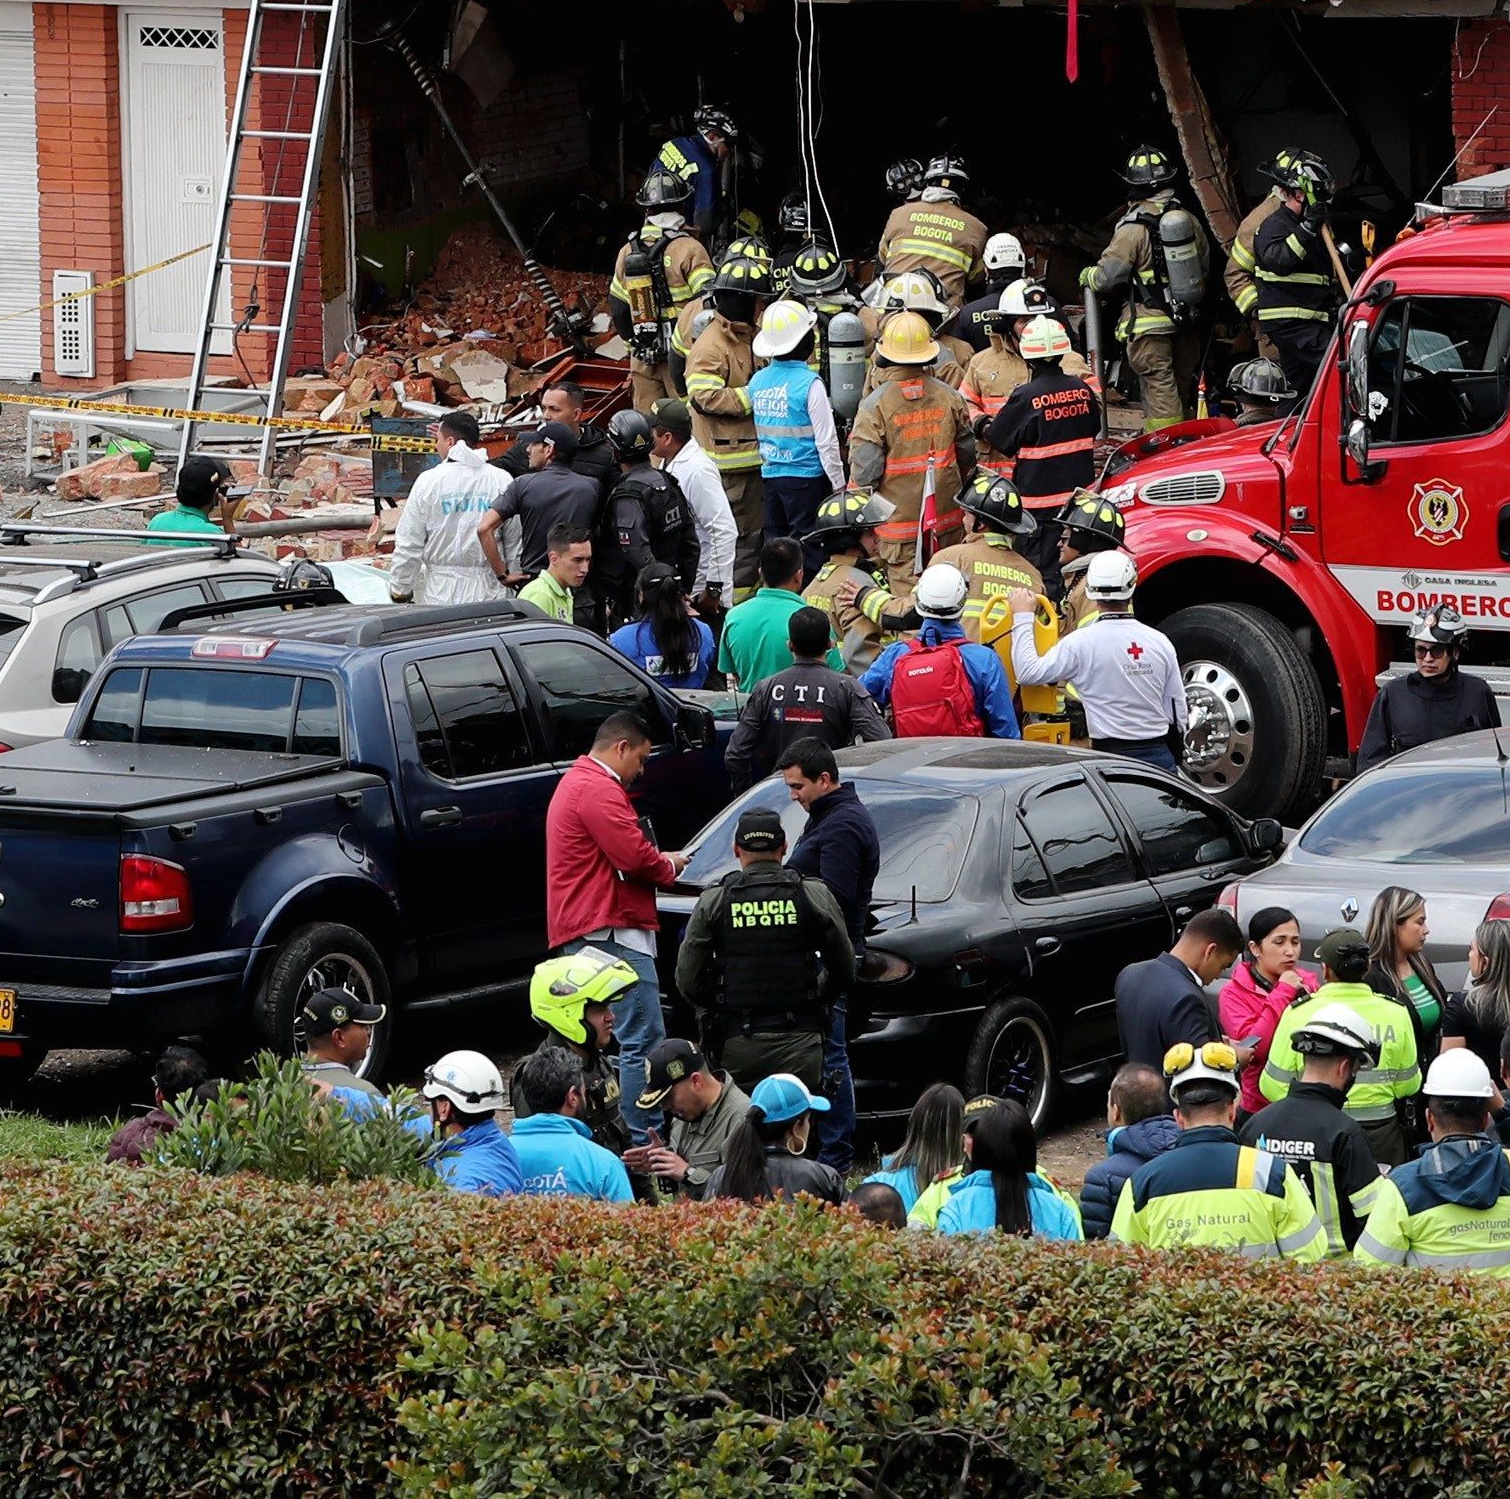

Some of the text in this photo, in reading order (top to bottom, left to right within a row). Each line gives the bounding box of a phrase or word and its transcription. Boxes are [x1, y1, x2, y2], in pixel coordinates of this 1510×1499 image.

[909, 212, 966, 232] BOMBEROS
[912, 225, 953, 243] BOGOTA
[1044, 399, 1090, 421] BOGOTÁ
[665, 505, 681, 523] CTI
[973, 561, 1033, 587] BOMBEROS
[1424, 576, 1499, 588] CASA INGLESA
[731, 899, 797, 917] POLICIA
[1265, 1139, 1315, 1156] IDIGER
[1165, 1211, 1252, 1230] Gas Natural
[1449, 1217, 1510, 1237] gasNatural
